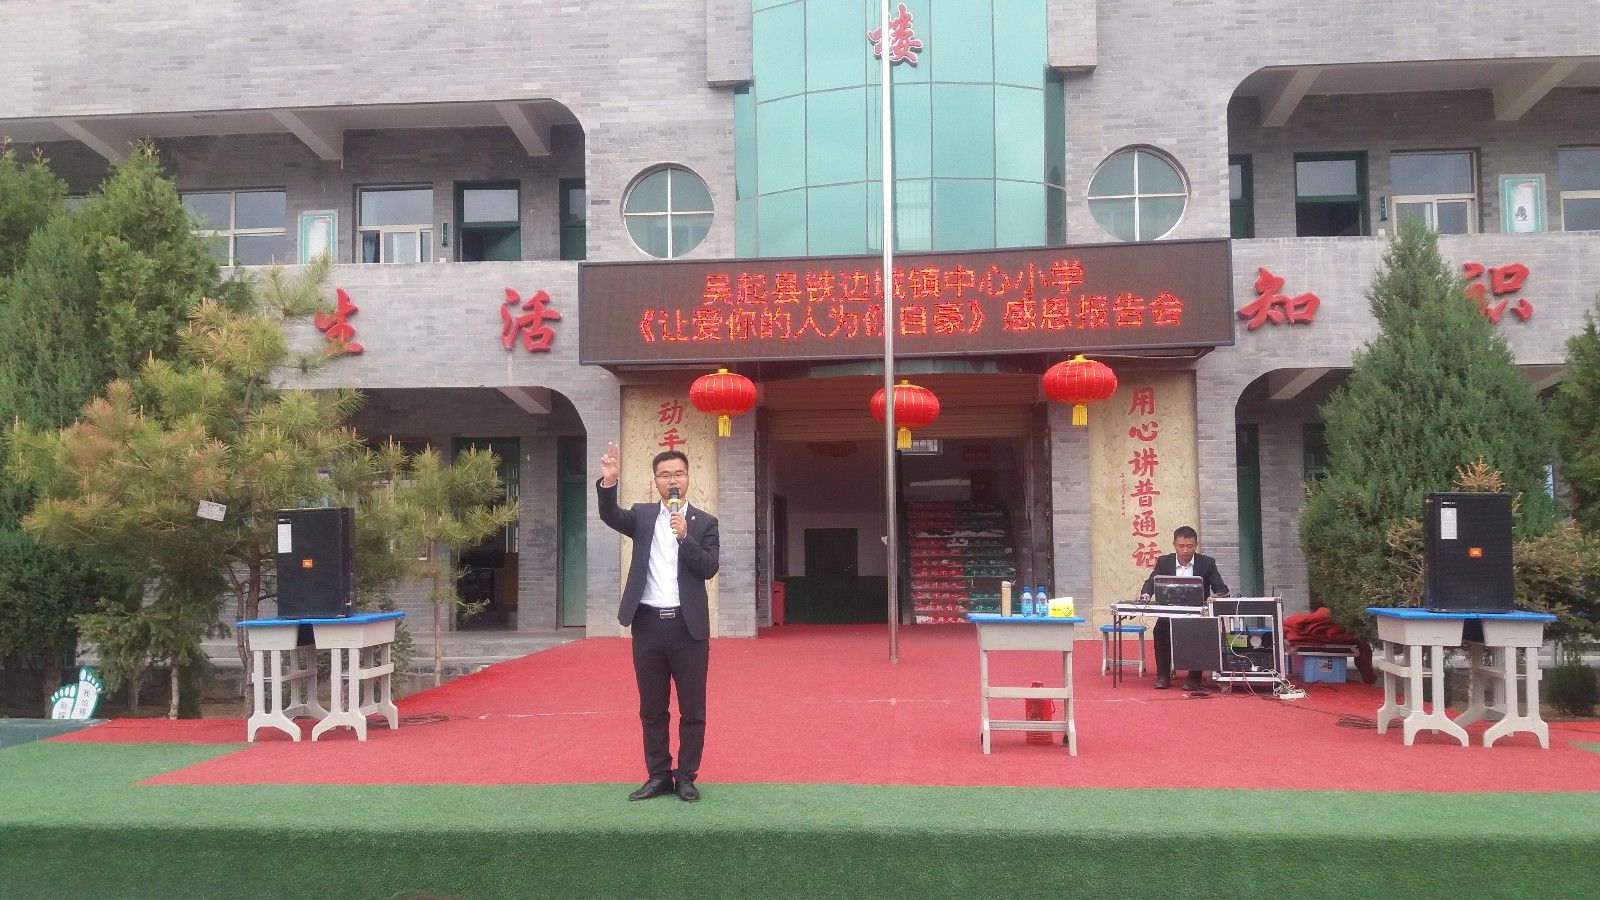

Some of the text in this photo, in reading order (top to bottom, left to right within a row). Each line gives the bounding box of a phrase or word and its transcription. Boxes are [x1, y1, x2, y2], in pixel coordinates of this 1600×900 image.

[868, 3, 923, 64] 楼
[703, 257, 1085, 305] 吴起县铁边城镇中心小学
[1237, 262, 1534, 331] 知 识
[500, 287, 563, 352] 活
[657, 400, 686, 452] 动手
[1127, 386, 1163, 568] 用心讲普通话
